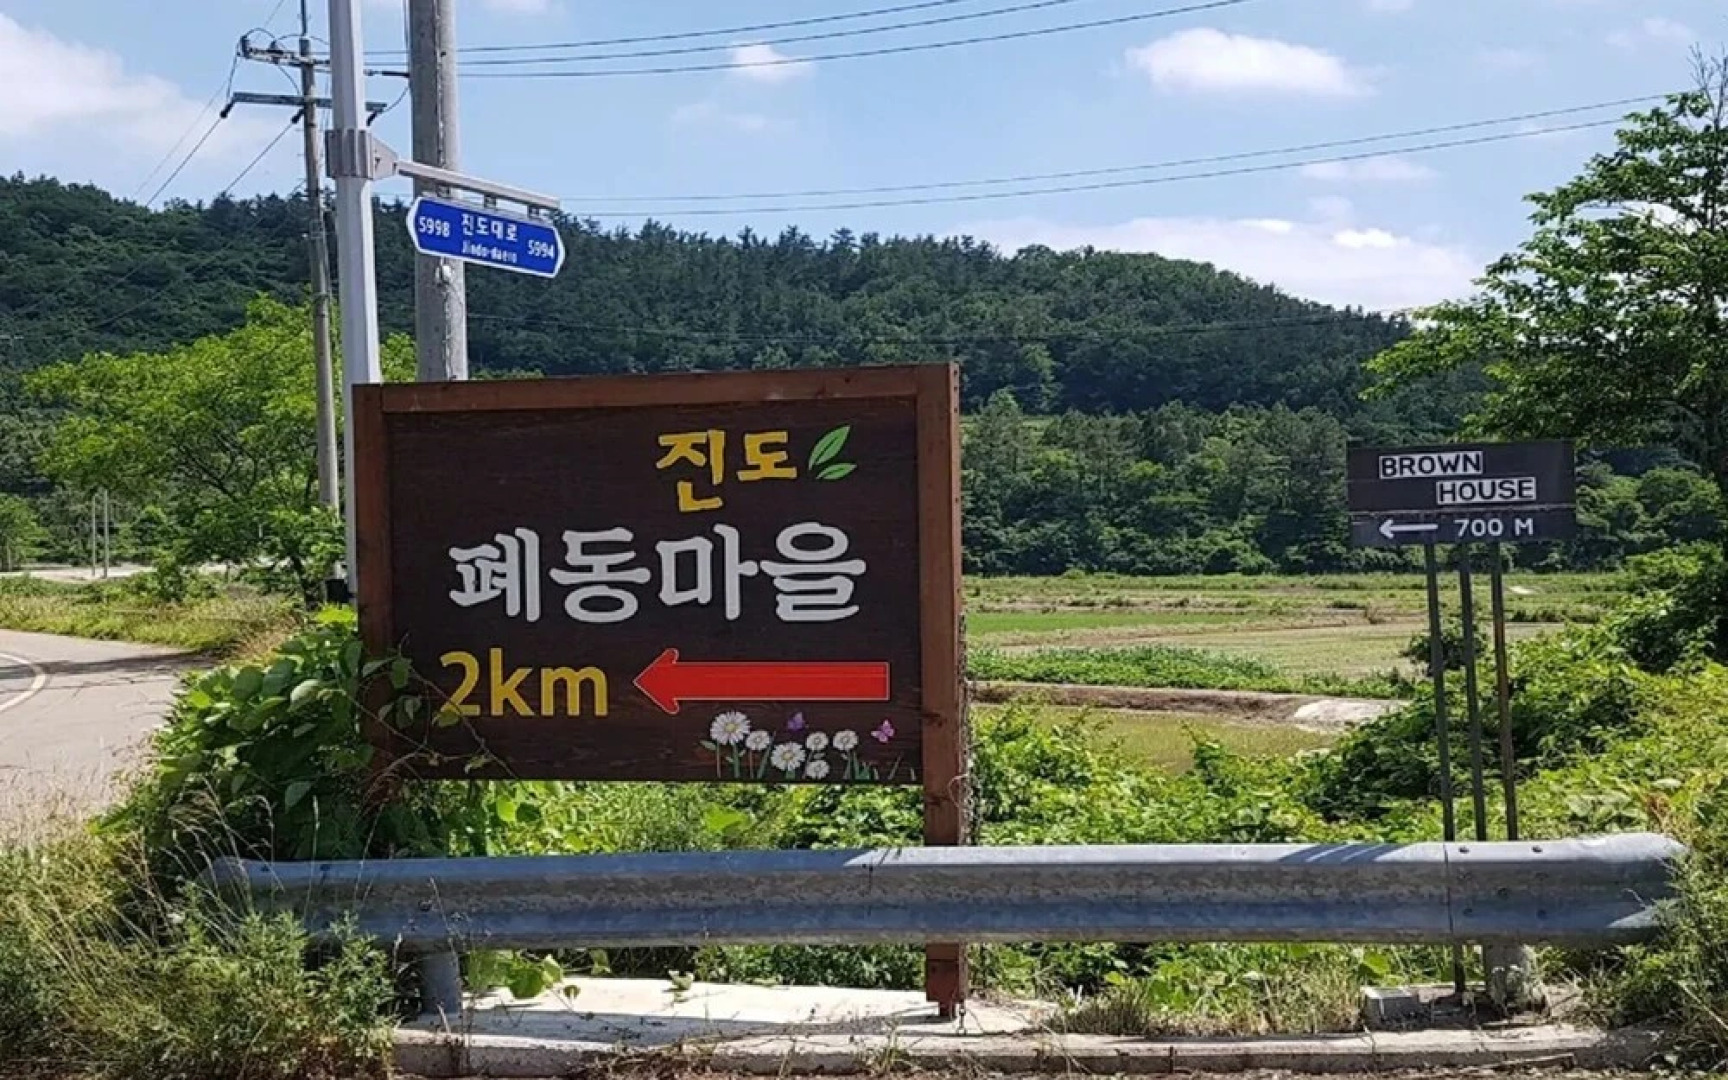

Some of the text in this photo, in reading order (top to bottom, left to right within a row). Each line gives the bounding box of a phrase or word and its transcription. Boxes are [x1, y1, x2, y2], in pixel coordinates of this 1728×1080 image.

[418, 215, 451, 238] 5998
[461, 213, 518, 242] 진도대로
[528, 239, 554, 260] 5994
[656, 428, 798, 513] 진도
[1381, 453, 1481, 477] BROWN
[1438, 479, 1534, 503] HOUSE
[1454, 517, 1535, 537] 700 M
[448, 521, 867, 624] 폐동마을
[439, 647, 609, 718] 2km
